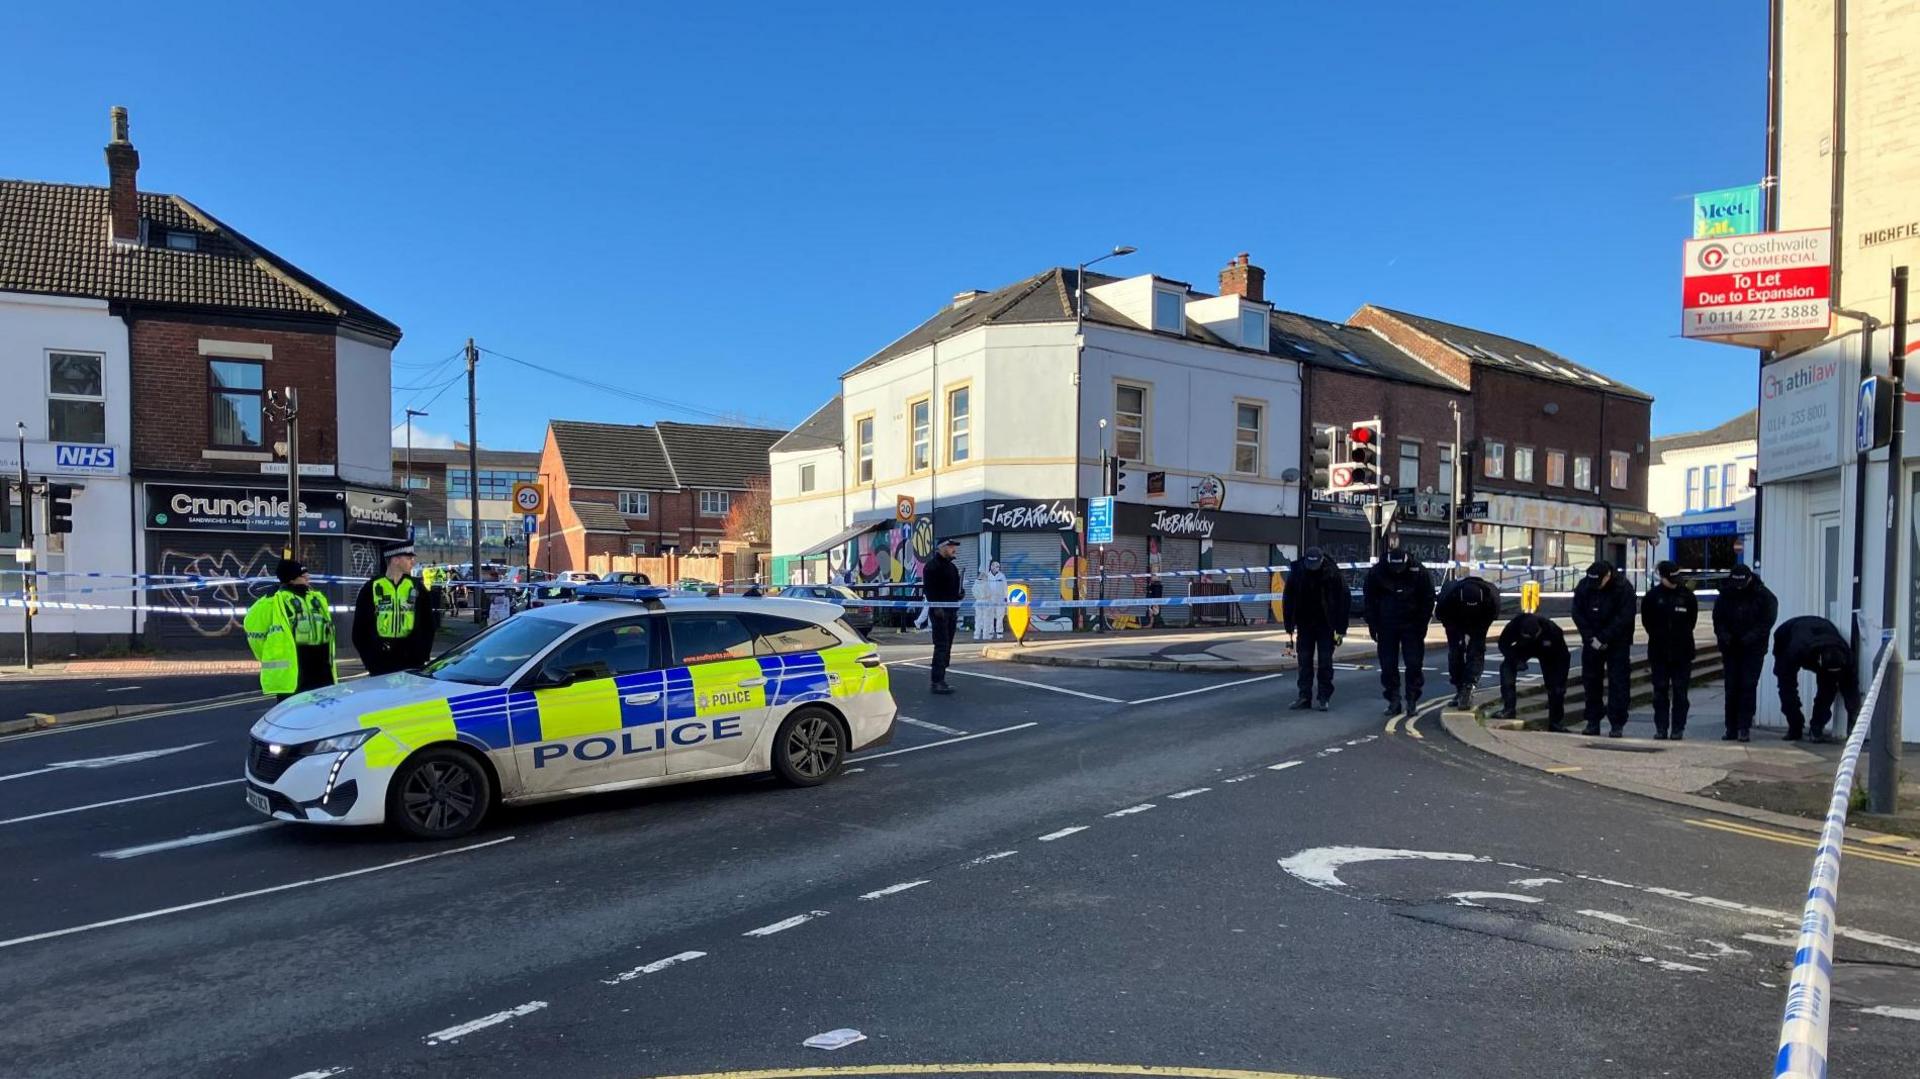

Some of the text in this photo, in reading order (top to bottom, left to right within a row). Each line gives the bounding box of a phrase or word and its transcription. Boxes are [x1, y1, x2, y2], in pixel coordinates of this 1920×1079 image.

[1700, 203, 1750, 219] Meet.
[1864, 222, 1919, 246] HIGHFIE
[1732, 237, 1819, 256] Crosthwaite
[1732, 252, 1818, 268] COMMERCIAL
[1732, 271, 1782, 289] To Let
[1698, 285, 1815, 305] Due to Expansion
[1695, 304, 1820, 325] T 0114 272 3888
[58, 446, 112, 467] NHS
[520, 493, 537, 504] 20
[901, 504, 911, 514] 20
[712, 690, 751, 707] POLICE
[533, 716, 743, 769] POLICE
